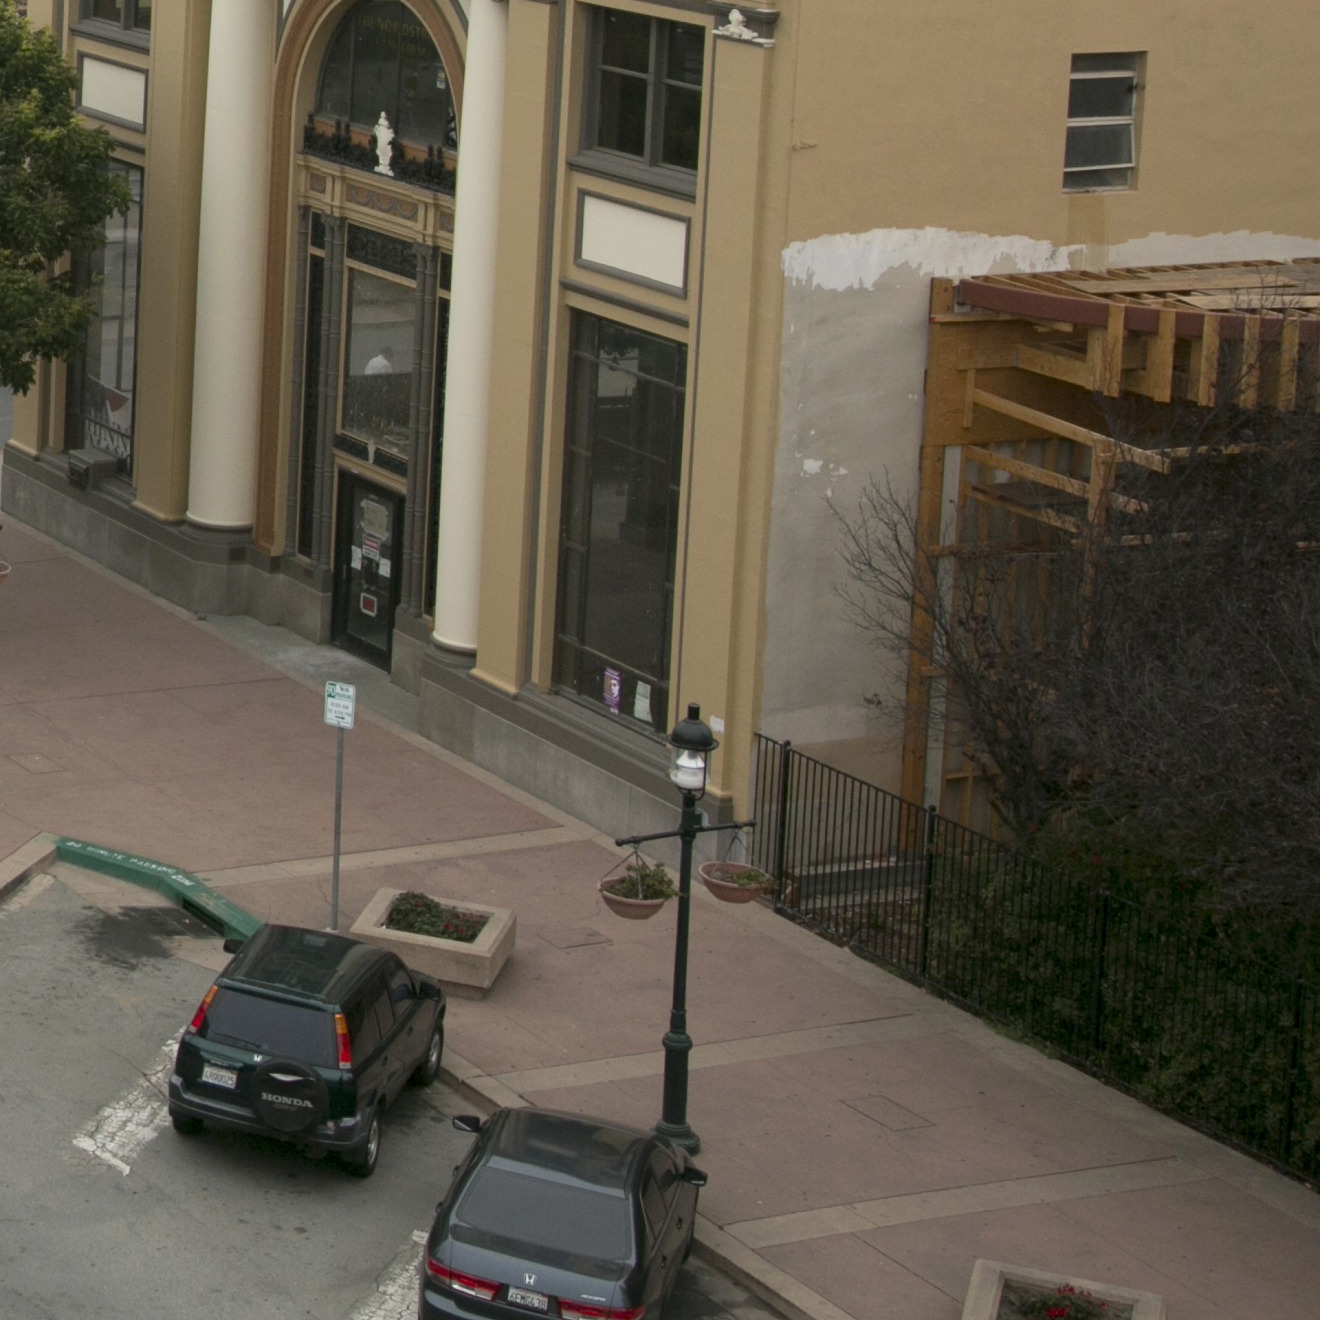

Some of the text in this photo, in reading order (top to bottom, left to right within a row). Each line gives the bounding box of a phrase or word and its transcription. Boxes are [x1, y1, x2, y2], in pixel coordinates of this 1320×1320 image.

[327, 684, 336, 696] 90
[86, 846, 126, 861] MINUTE
[129, 858, 177, 874] PARKING
[261, 1092, 313, 1108] HONDA
